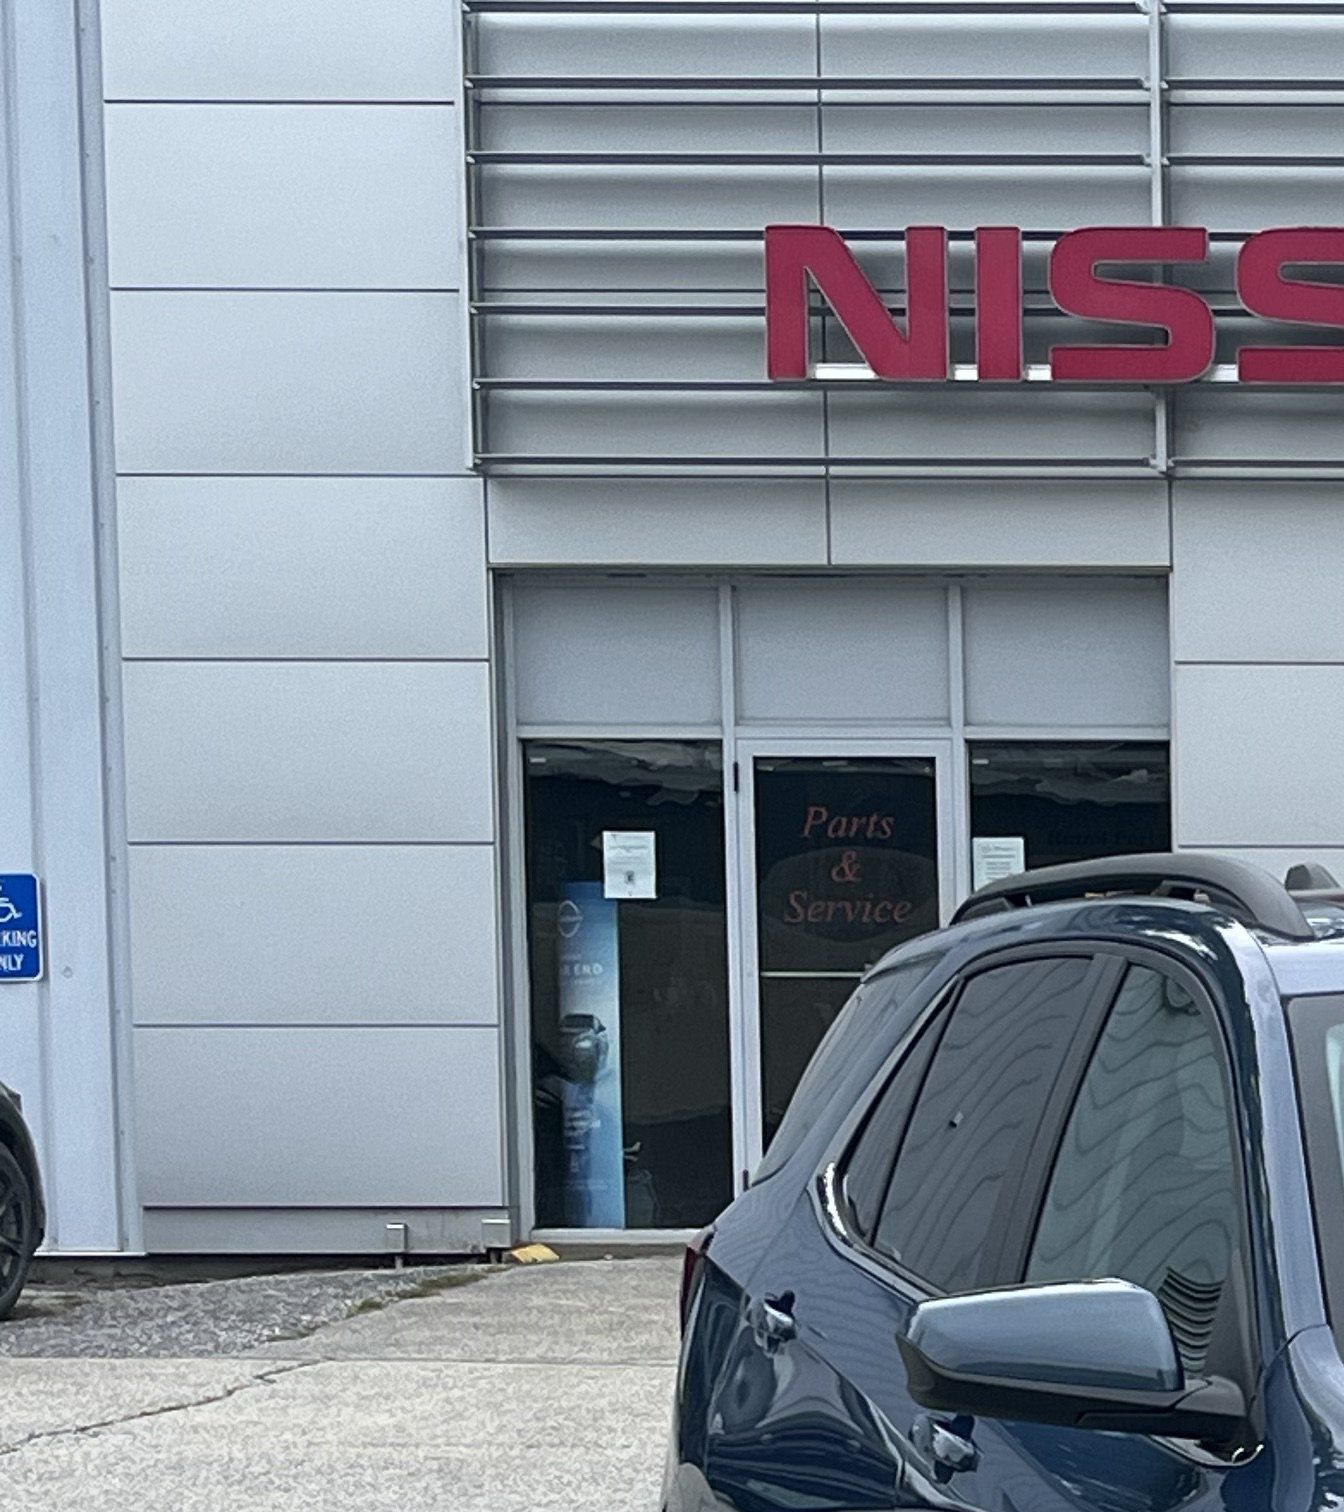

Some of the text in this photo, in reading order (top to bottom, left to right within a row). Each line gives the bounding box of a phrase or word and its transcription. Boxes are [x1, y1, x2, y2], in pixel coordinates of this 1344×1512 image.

[800, 805, 896, 839] Parts
[831, 850, 862, 882] &
[784, 890, 912, 923] Service
[0, 929, 37, 949] KING
